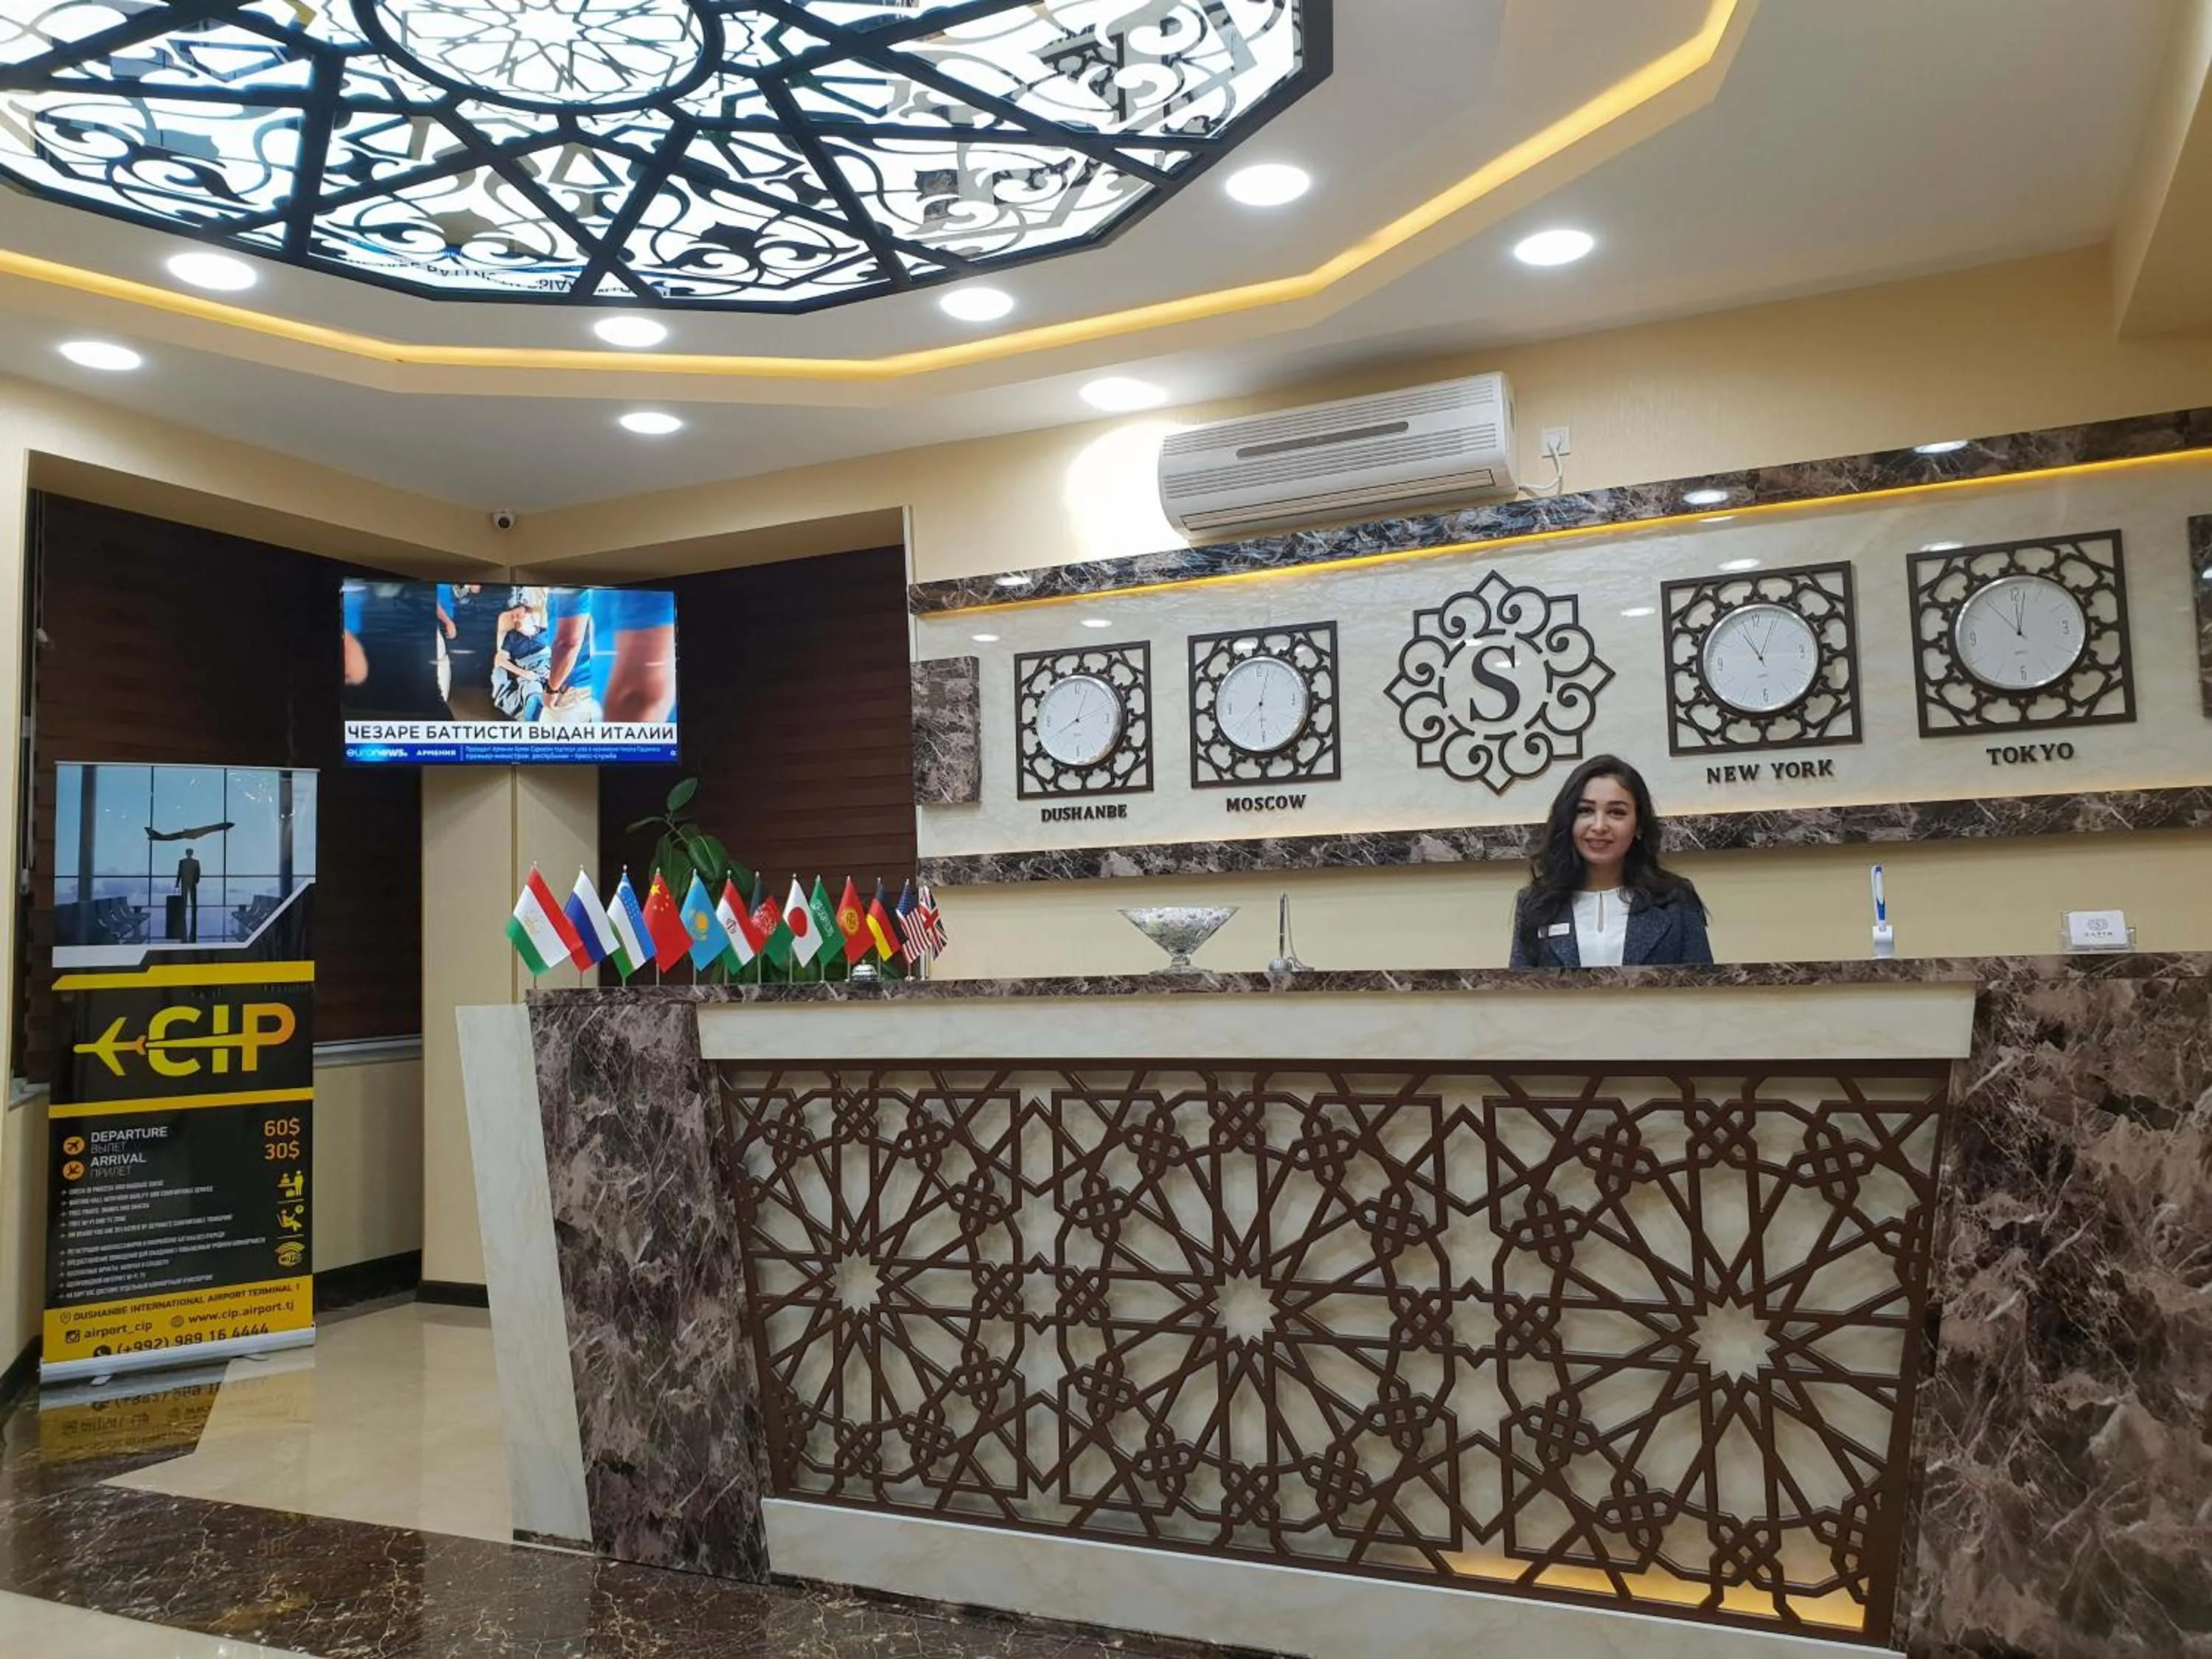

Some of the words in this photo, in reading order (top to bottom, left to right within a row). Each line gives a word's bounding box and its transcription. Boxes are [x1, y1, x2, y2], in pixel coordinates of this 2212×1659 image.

[347, 725, 420, 740] ЧЕЗАРЕ
[426, 726, 523, 740] БАТТИСТИ
[529, 726, 594, 742] ВЫДАН
[601, 727, 674, 740] ИТАЛИИ
[1986, 742, 2075, 766] TOKYO
[1706, 764, 1760, 785] NEW
[1770, 759, 1834, 780] YORK
[1226, 794, 1307, 813] MOSCOW
[1040, 804, 1128, 823] DUSHANBE
[147, 1002, 296, 1077] CIP
[91, 1126, 169, 1143] DEPARTURE
[265, 1117, 300, 1136] 60$
[91, 1141, 127, 1155] ВЫЛЕТ
[265, 1140, 300, 1161] 30$
[91, 1152, 147, 1167] ARRIVAL
[74, 1305, 128, 1321] DUSHANBE
[131, 1297, 204, 1314] INTERNATIONAL
[208, 1290, 246, 1304] AIRPORT
[248, 1284, 293, 1298] TERMINAL
[189, 1300, 294, 1324] www.cip.airport.tj
[84, 1321, 153, 1339] airport_cip
[175, 1332, 203, 1346] 989
[232, 1323, 269, 1339] 4444
